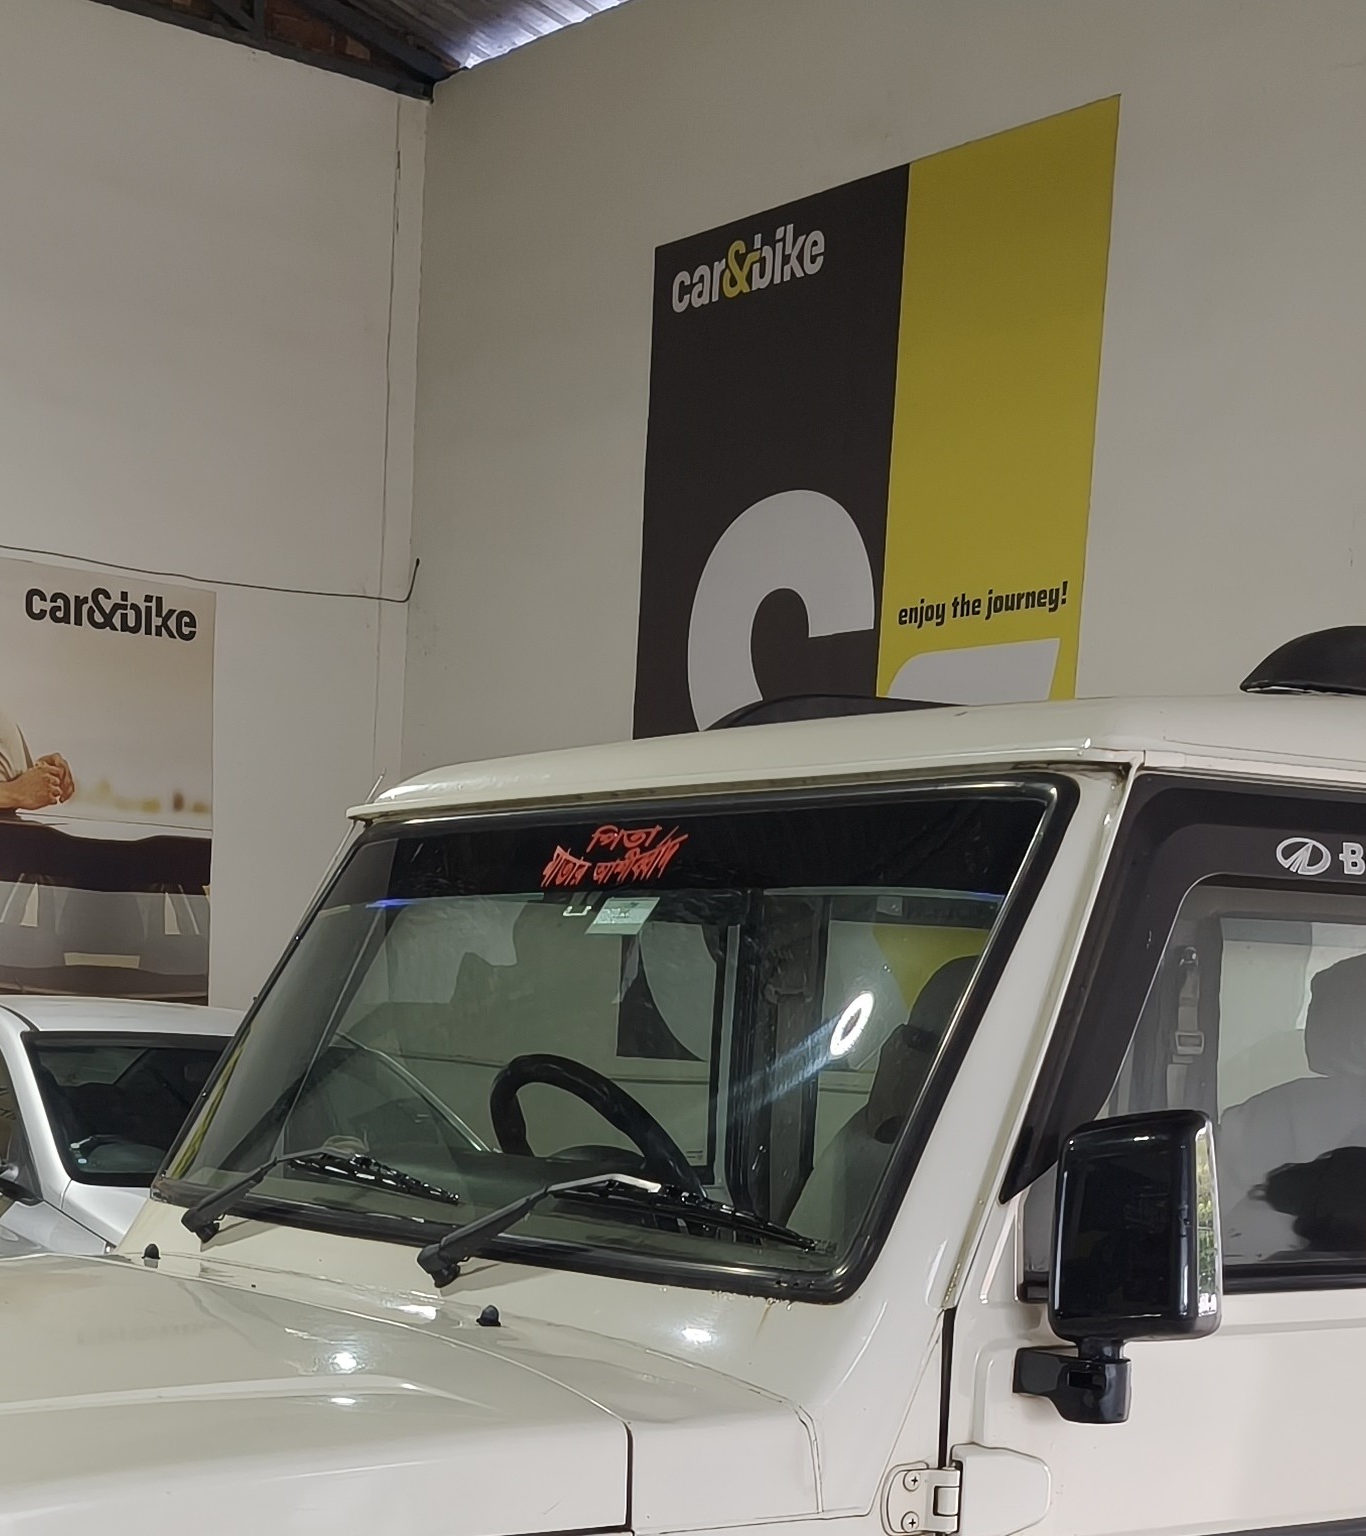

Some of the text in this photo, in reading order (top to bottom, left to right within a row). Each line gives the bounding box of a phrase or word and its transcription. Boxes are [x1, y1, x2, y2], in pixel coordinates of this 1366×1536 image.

[671, 224, 825, 313] car&bike
[24, 587, 198, 641] car&bike
[898, 580, 1069, 629] enjoy the journey!
